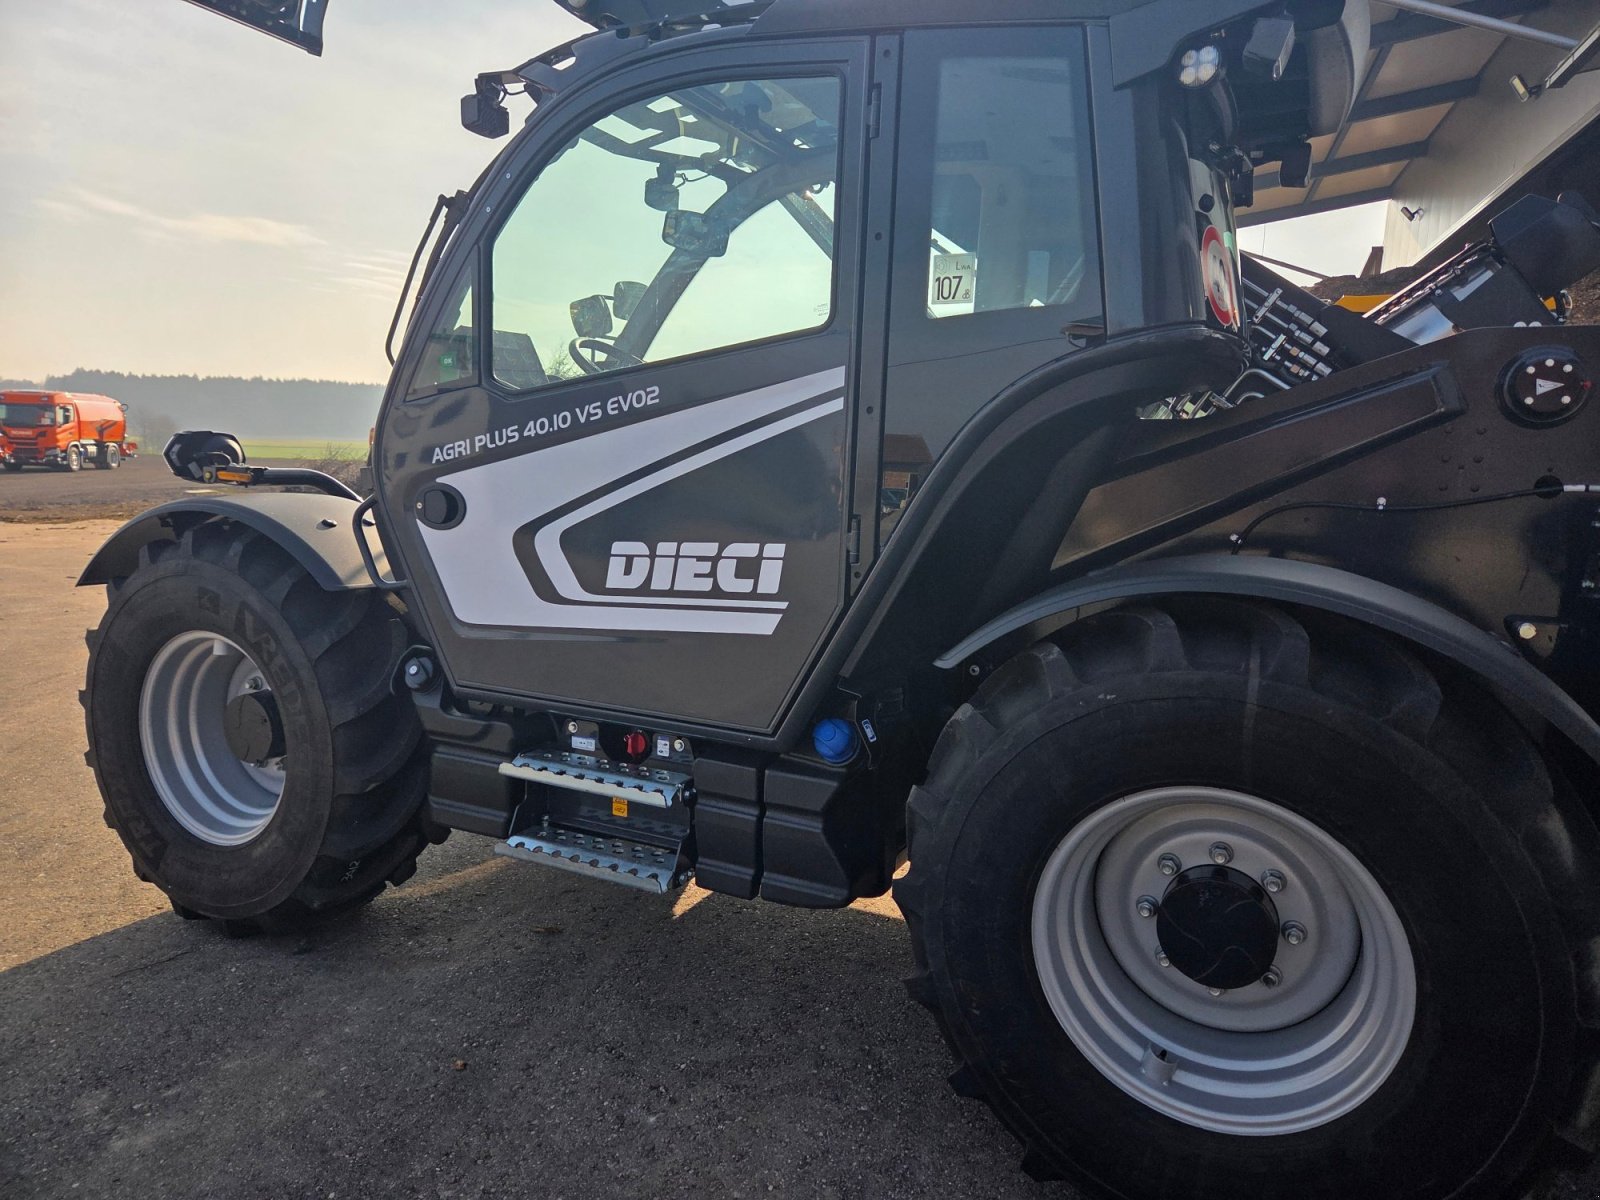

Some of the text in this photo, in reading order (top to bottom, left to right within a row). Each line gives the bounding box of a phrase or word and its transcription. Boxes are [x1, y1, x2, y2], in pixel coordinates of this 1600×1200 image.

[935, 275, 963, 301] 107
[431, 385, 661, 464] AGRI PLUS 40.10 VS EVO2
[603, 541, 787, 594] DIECI
